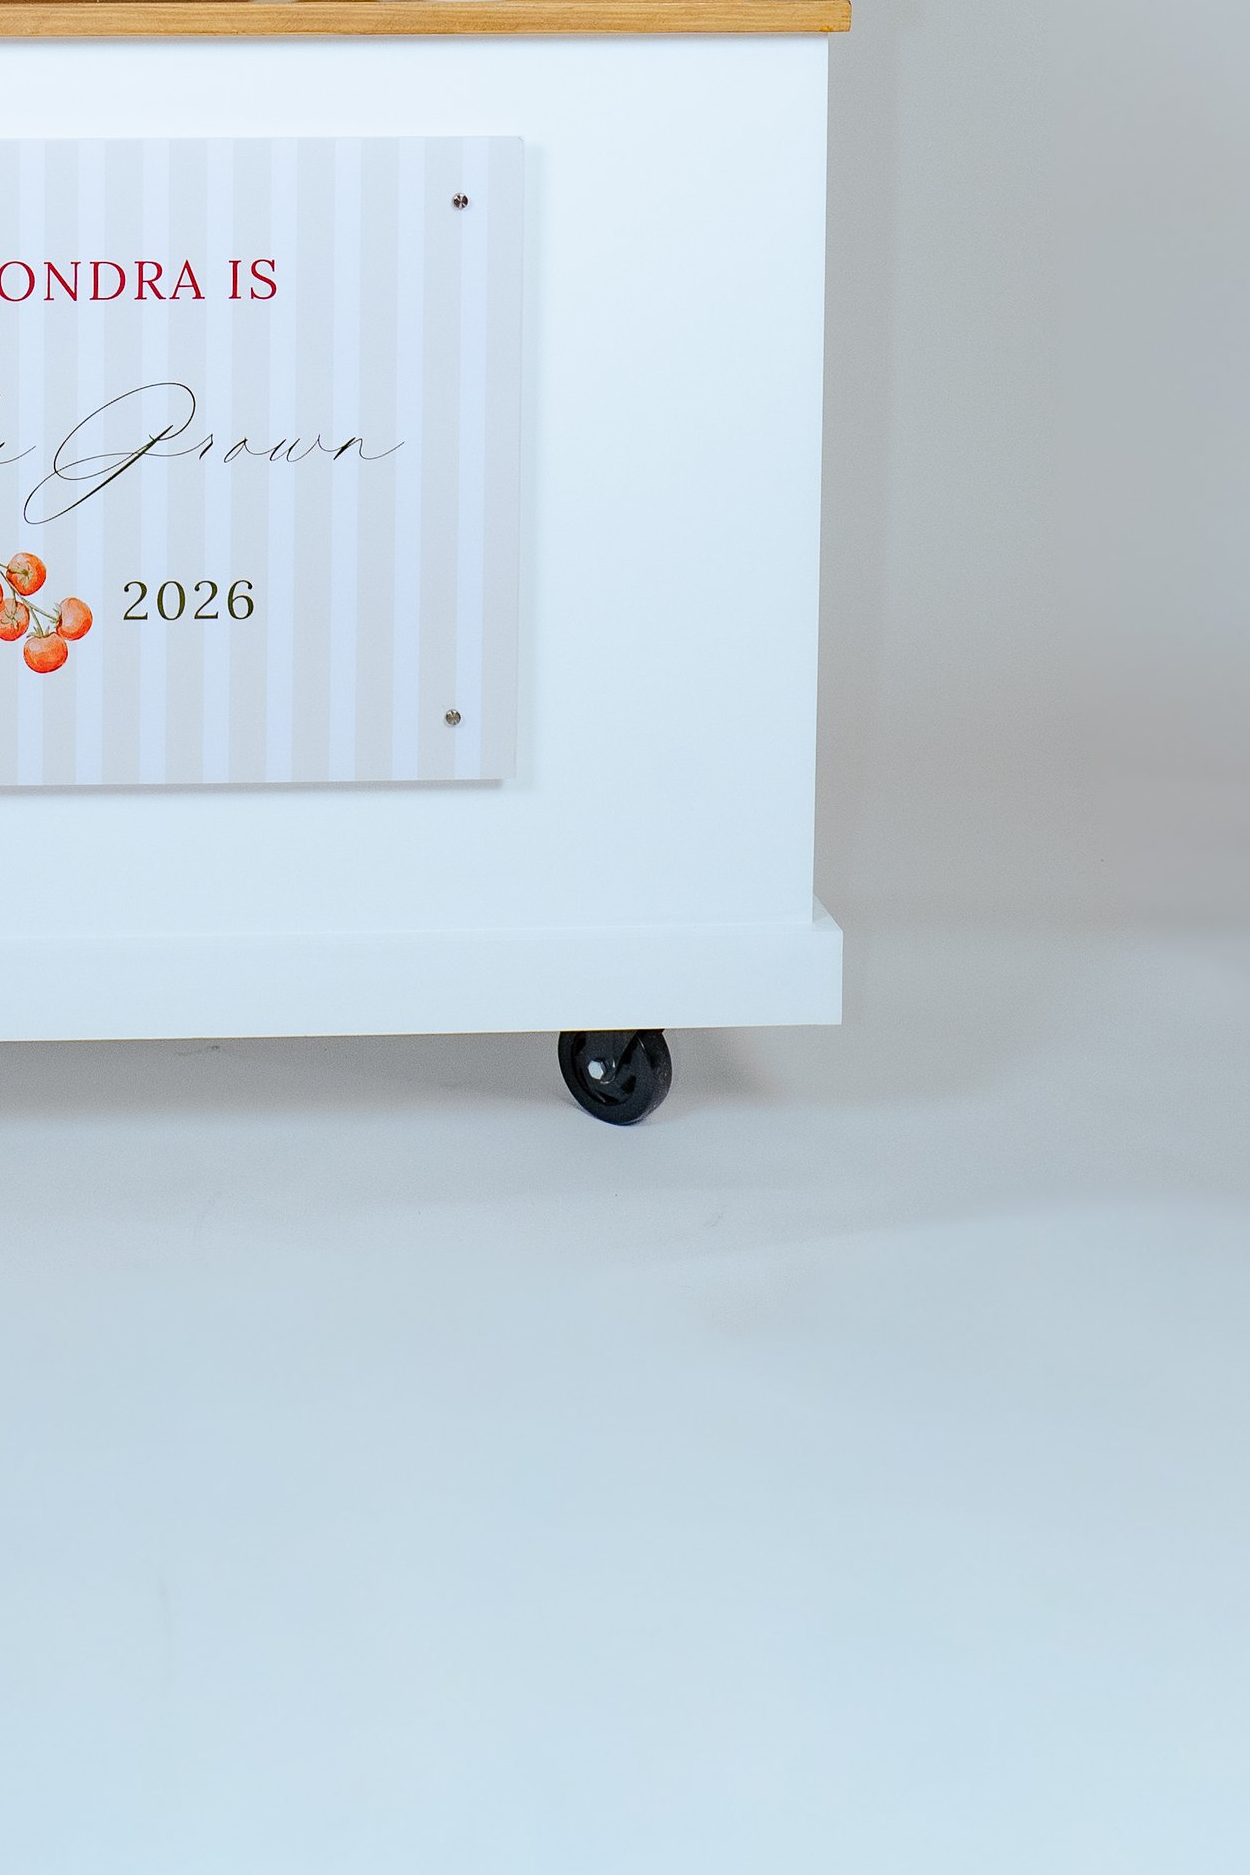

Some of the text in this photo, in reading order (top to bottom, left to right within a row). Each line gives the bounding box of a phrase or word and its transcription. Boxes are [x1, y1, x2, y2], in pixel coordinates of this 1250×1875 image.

[228, 257, 278, 301] IS
[22, 381, 406, 526] Grown
[122, 579, 256, 622] 2026
